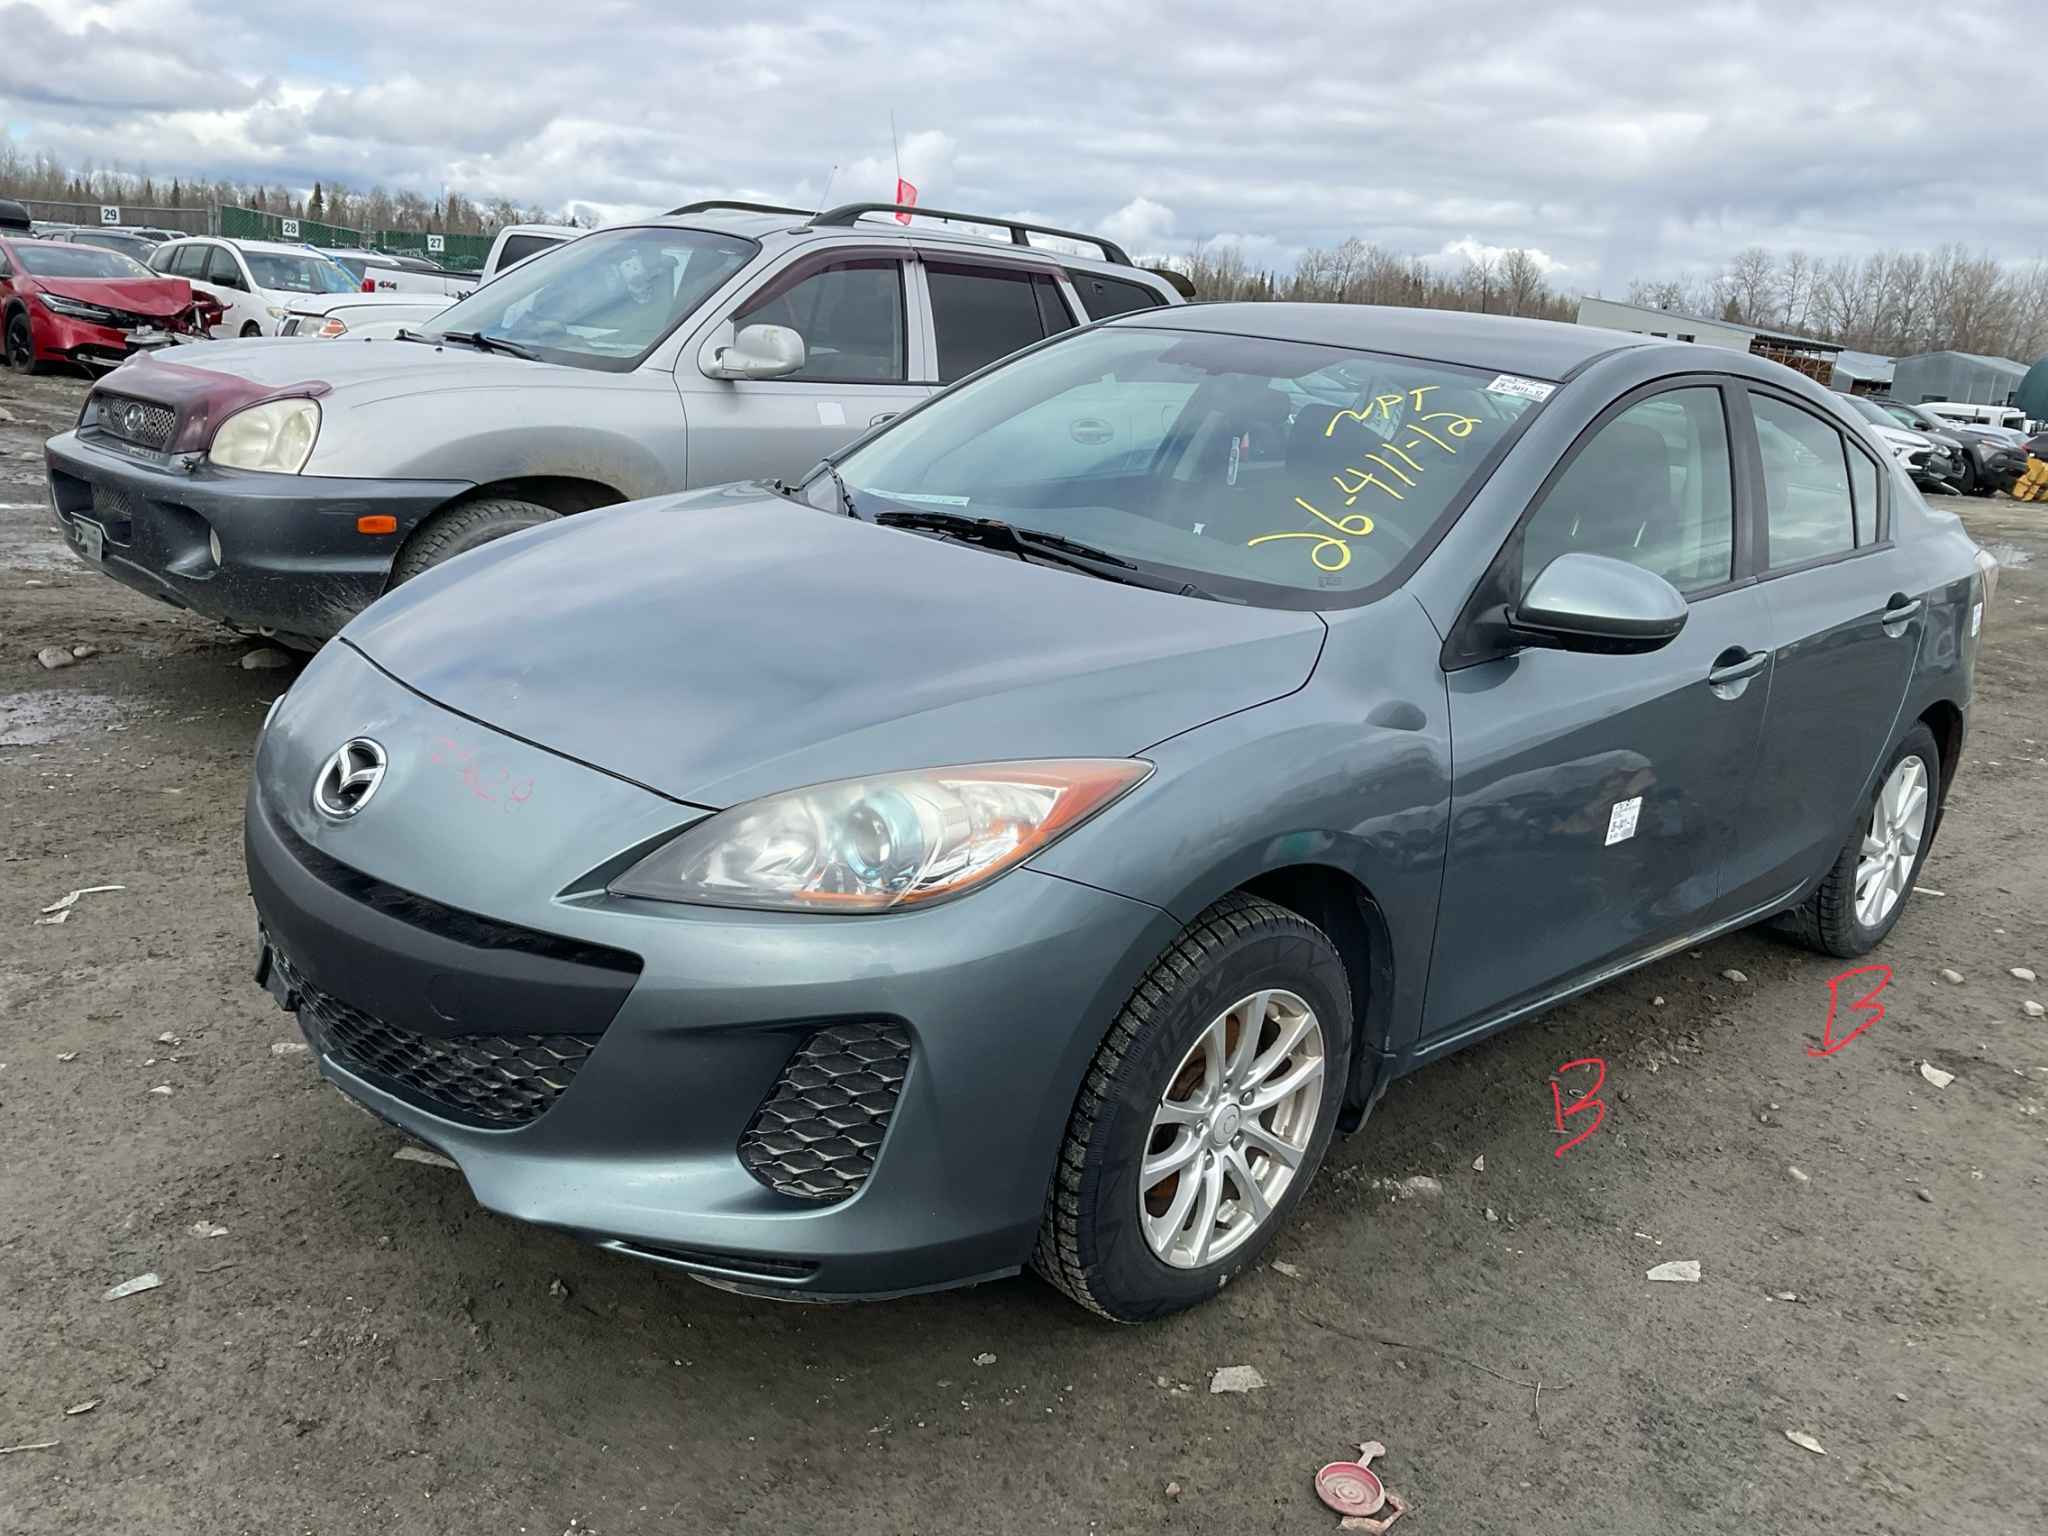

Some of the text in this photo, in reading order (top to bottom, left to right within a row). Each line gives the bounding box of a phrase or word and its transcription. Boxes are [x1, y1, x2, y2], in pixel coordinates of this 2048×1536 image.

[104, 208, 117, 220] 29
[284, 221, 297, 234] 28
[430, 238, 442, 248] 27
